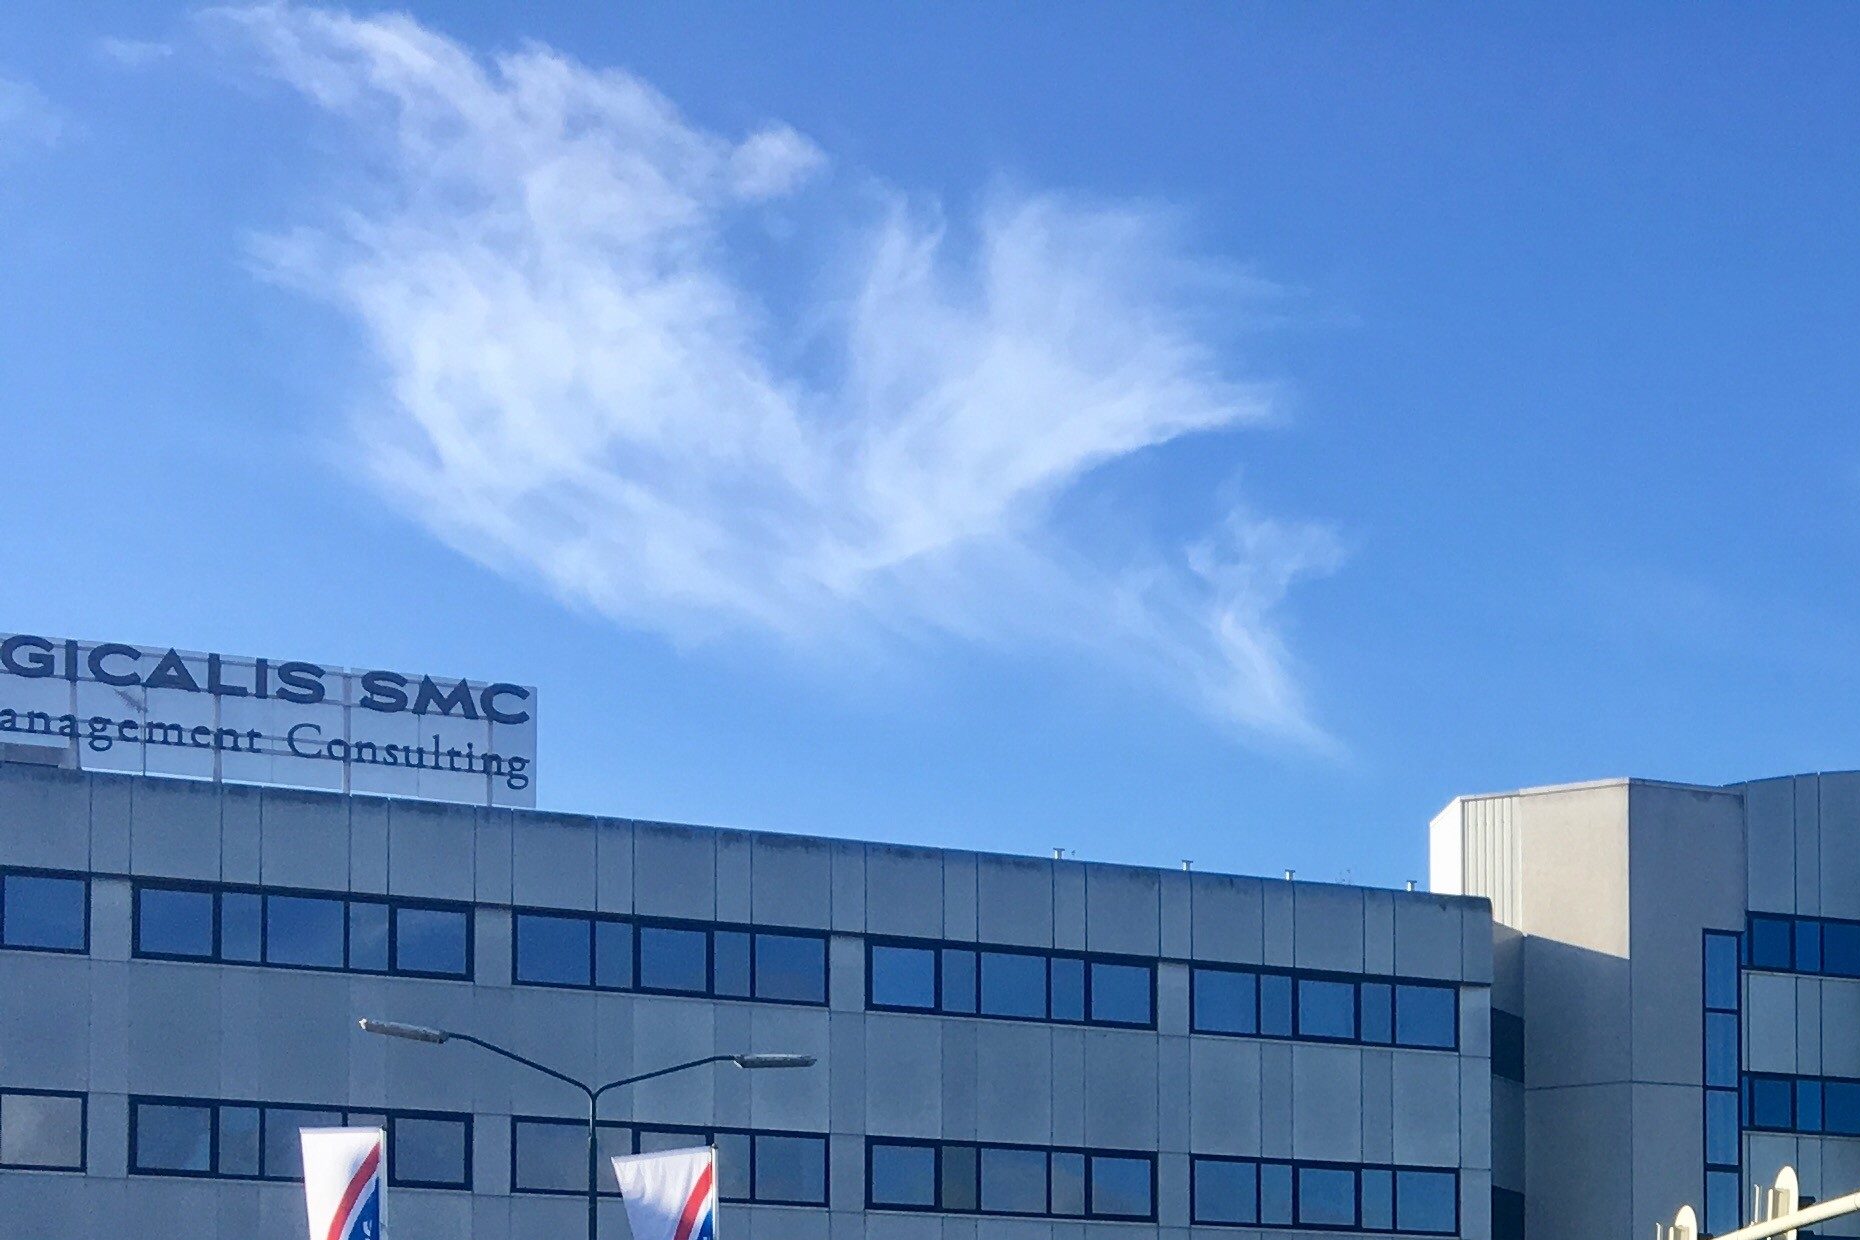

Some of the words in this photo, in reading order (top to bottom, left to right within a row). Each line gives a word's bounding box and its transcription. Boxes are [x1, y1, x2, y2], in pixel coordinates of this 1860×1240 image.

[1, 634, 326, 704] GICALIS
[359, 669, 531, 725] SMC
[0, 706, 263, 752] anagement
[286, 722, 531, 791] Consulting
